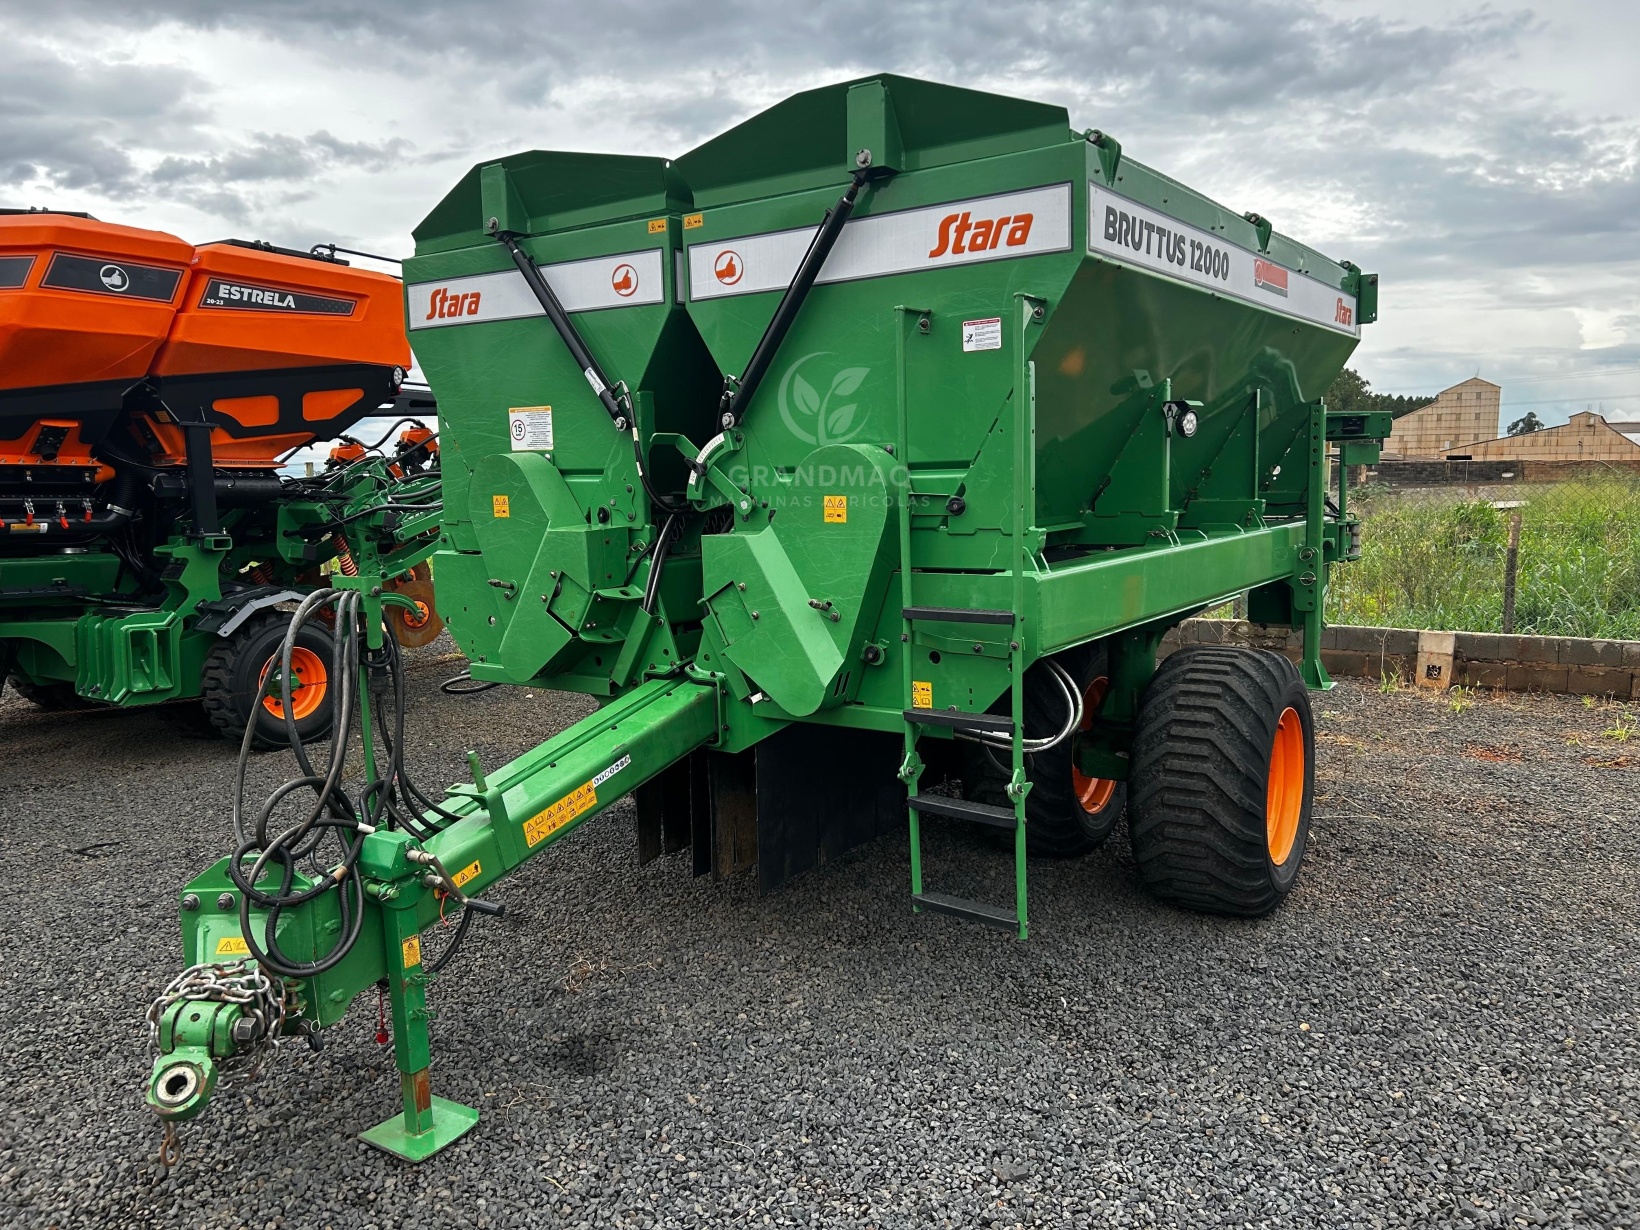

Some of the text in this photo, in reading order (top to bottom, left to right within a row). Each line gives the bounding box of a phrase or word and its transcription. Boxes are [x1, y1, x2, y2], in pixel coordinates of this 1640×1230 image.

[928, 211, 1034, 259] Stara
[1104, 205, 1186, 267] BRUTTUS
[1190, 239, 1230, 281] 12000
[206, 298, 224, 306] 20-23
[218, 283, 296, 309] ESTRELA
[425, 287, 482, 321] Stara
[1334, 297, 1352, 327] Stara
[514, 423, 523, 433] 15
